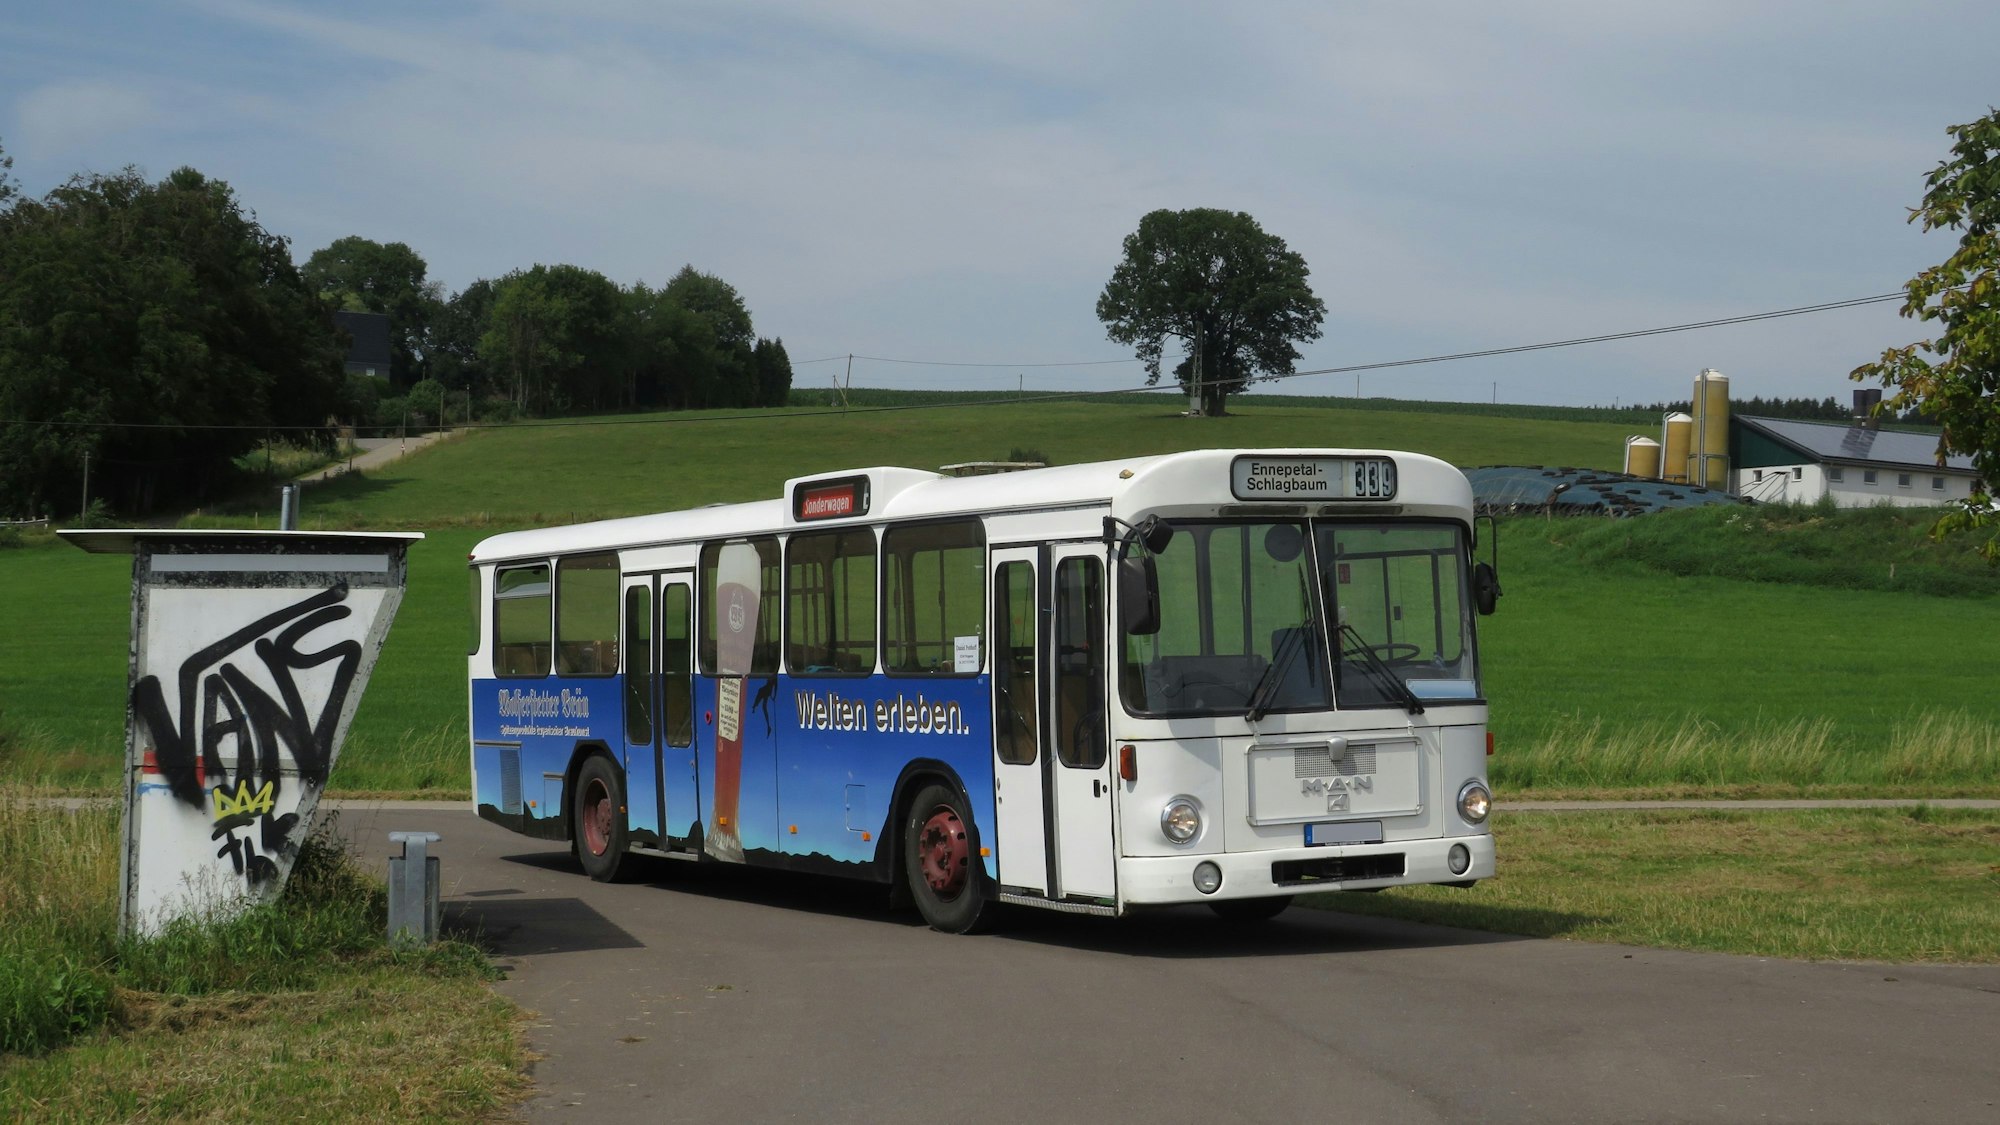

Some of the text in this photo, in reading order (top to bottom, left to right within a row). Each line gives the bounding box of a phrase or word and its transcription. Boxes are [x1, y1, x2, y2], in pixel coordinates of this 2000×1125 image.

[1251, 463, 1323, 478] Ennepetal-
[1354, 461, 1393, 497] 339
[1247, 478, 1327, 493] Schlagbaum
[805, 496, 850, 515] Sonderwagen
[795, 689, 970, 735] Welten erleben.
